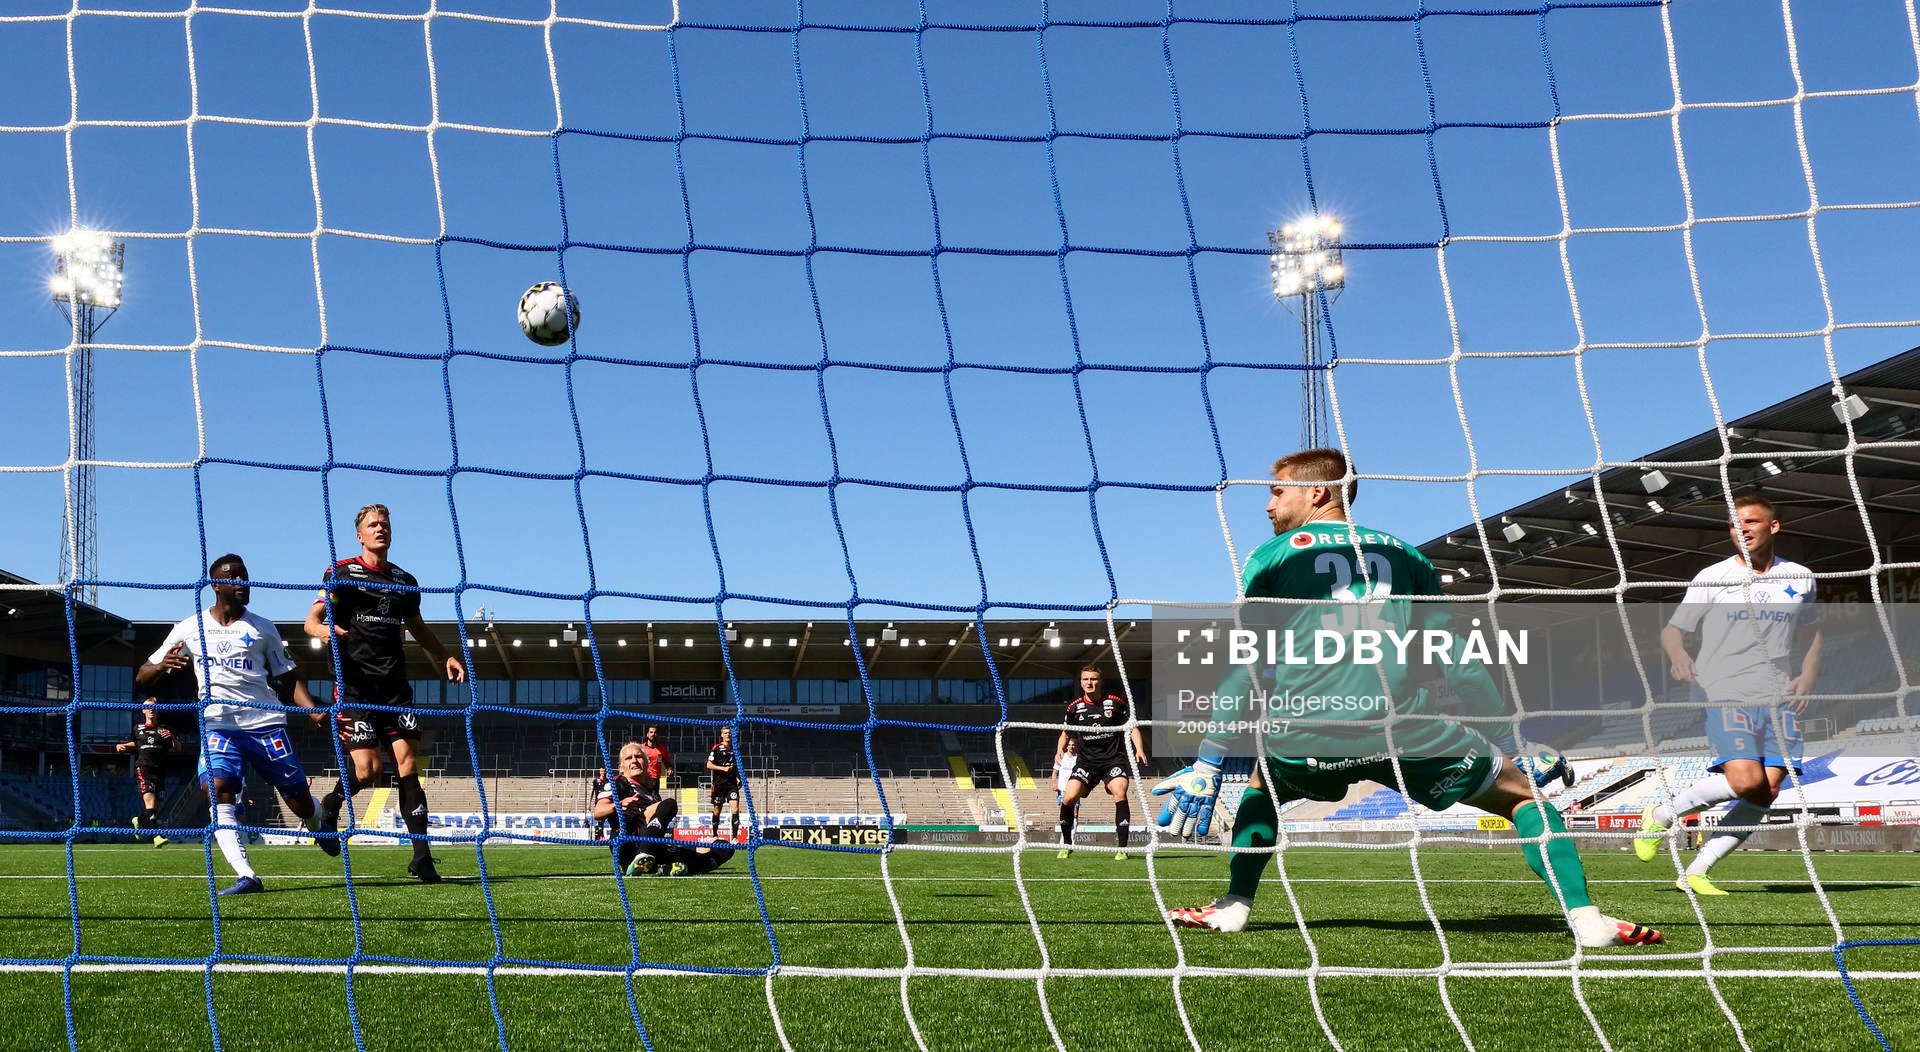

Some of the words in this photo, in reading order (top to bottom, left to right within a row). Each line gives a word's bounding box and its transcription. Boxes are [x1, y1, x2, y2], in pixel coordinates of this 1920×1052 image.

[1318, 533, 1404, 550] REDEYE
[1314, 552, 1396, 638] 32
[660, 684, 716, 697] stadium
[807, 829, 890, 845] XL-BYGG
